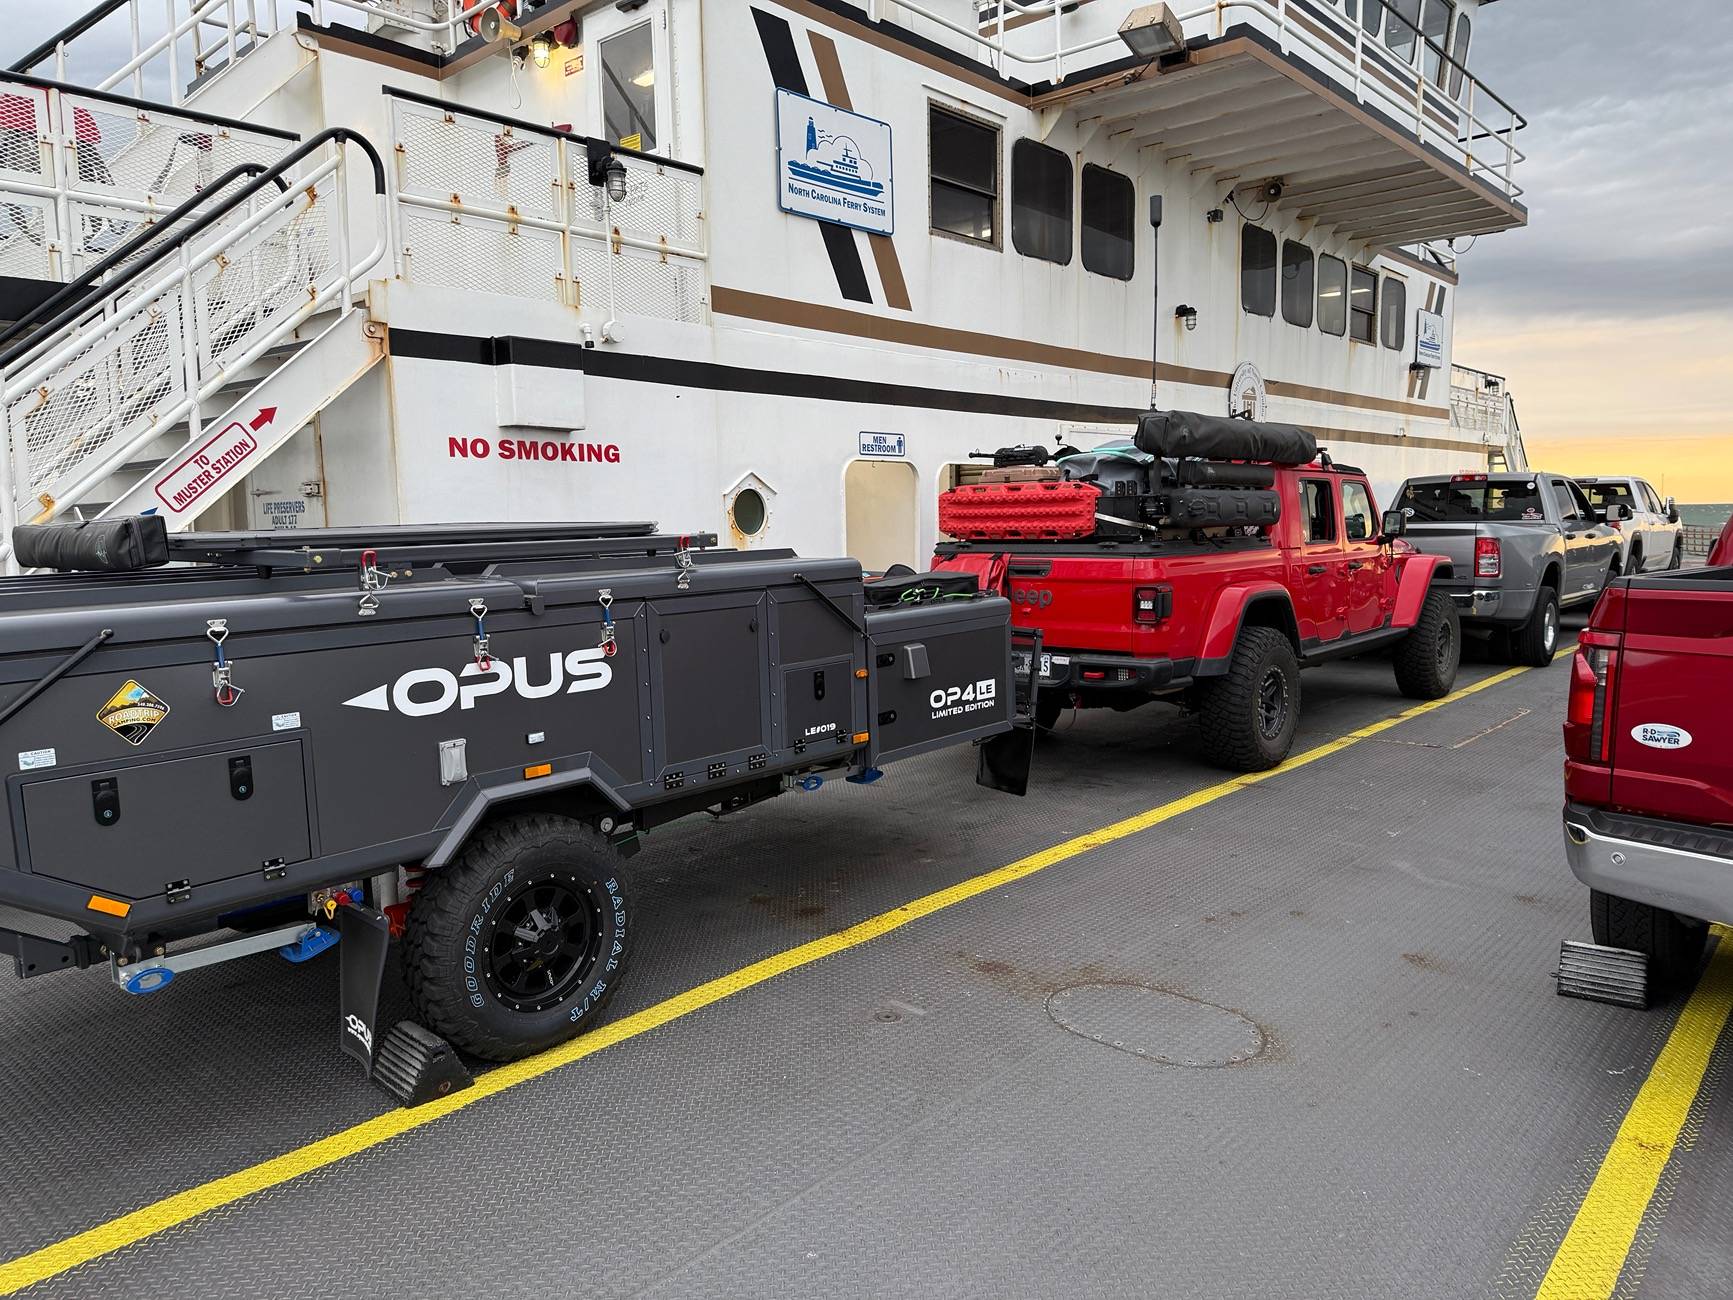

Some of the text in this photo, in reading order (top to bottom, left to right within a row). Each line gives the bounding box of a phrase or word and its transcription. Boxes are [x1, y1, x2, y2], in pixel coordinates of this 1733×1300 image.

[788, 182, 886, 217] NORTH CAROLINA FERRY SYSTEM
[448, 436, 621, 464] NO SMOKING
[861, 443, 897, 454] RESTROOM
[872, 435, 887, 445] MEN
[193, 454, 210, 470] TO
[172, 438, 251, 507] MUSTER STATION
[262, 500, 306, 515] LIFE PRESERVERS
[271, 514, 288, 526] ADULT
[1013, 589, 1053, 609] eep
[392, 647, 613, 717] OPUS
[929, 681, 994, 709] OP4 LE
[108, 708, 160, 724] ROADTRIP
[931, 699, 995, 720] LIMITED EDITION
[112, 716, 156, 727] CAMPING.COM
[1641, 734, 1680, 745] SAWYER
[464, 868, 515, 1008] GOODRIDE
[570, 877, 626, 1022] RADIAL M/T
